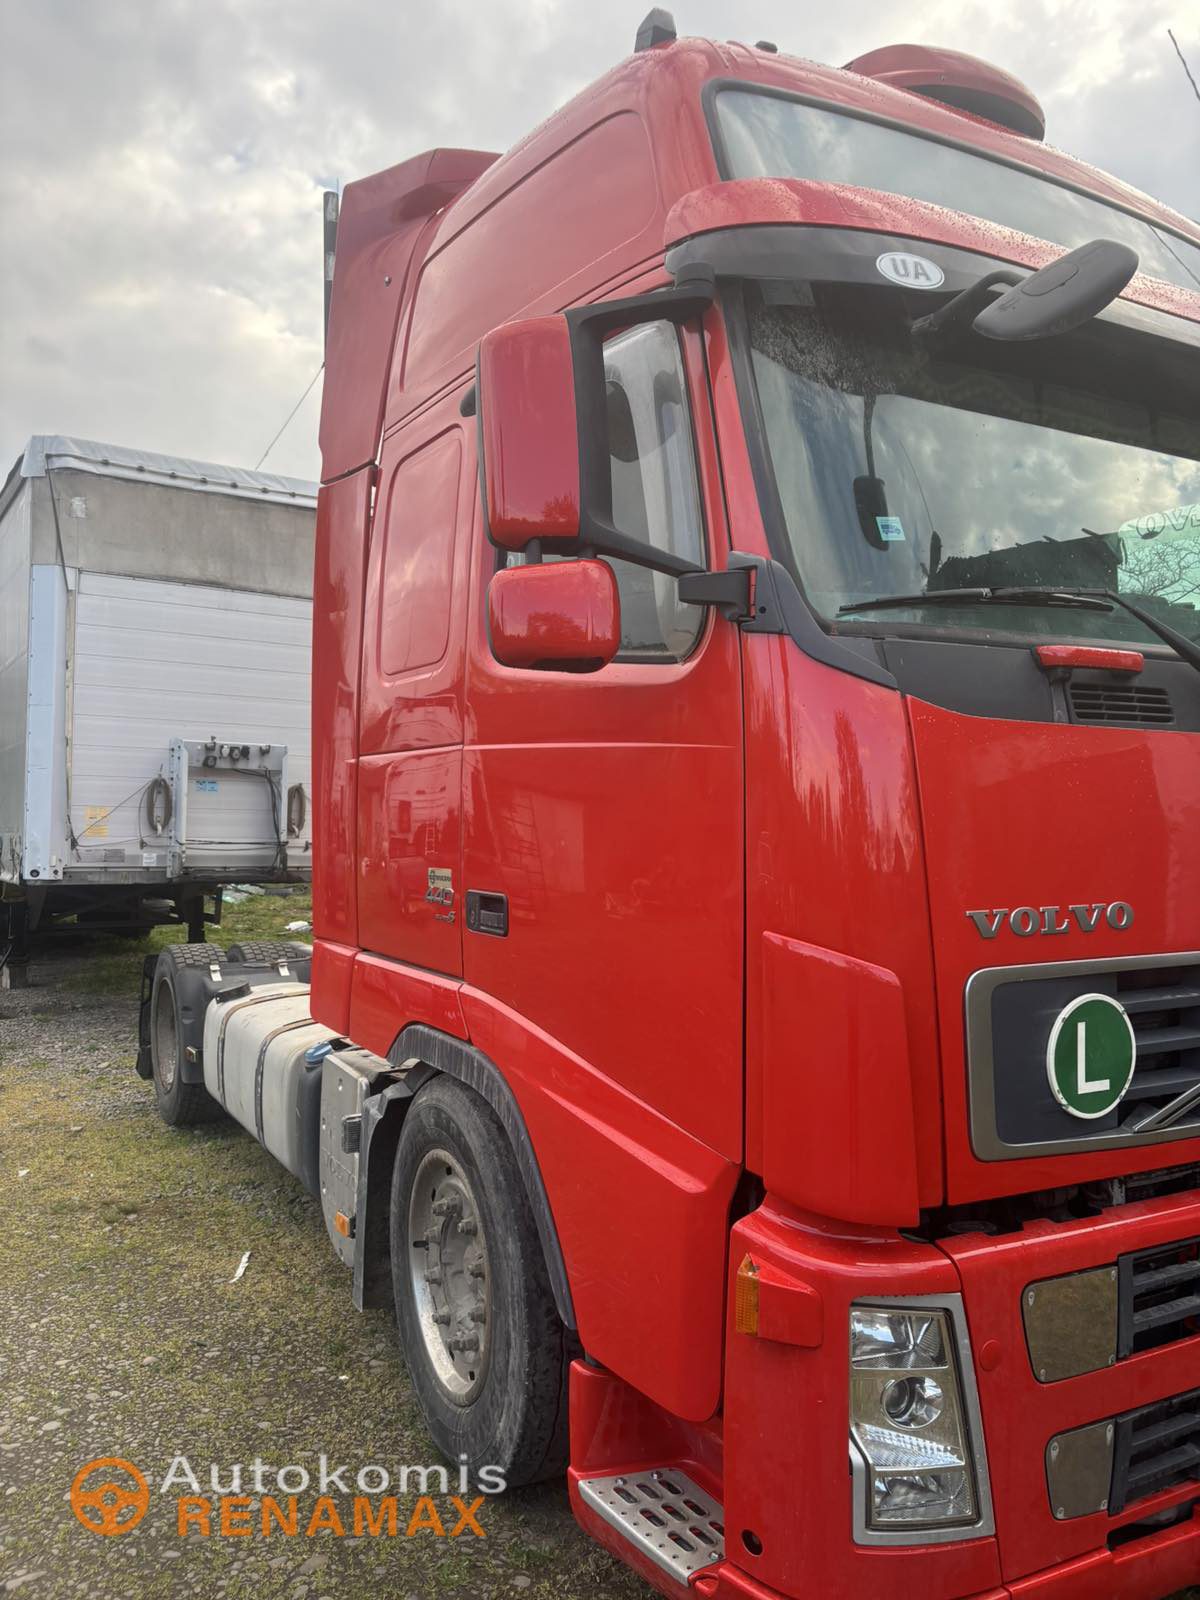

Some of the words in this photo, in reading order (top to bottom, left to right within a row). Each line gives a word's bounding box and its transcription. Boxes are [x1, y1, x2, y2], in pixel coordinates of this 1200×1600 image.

[889, 257, 933, 282] UA
[966, 901, 1134, 939] VOLVO
[1077, 1021, 1111, 1095] L
